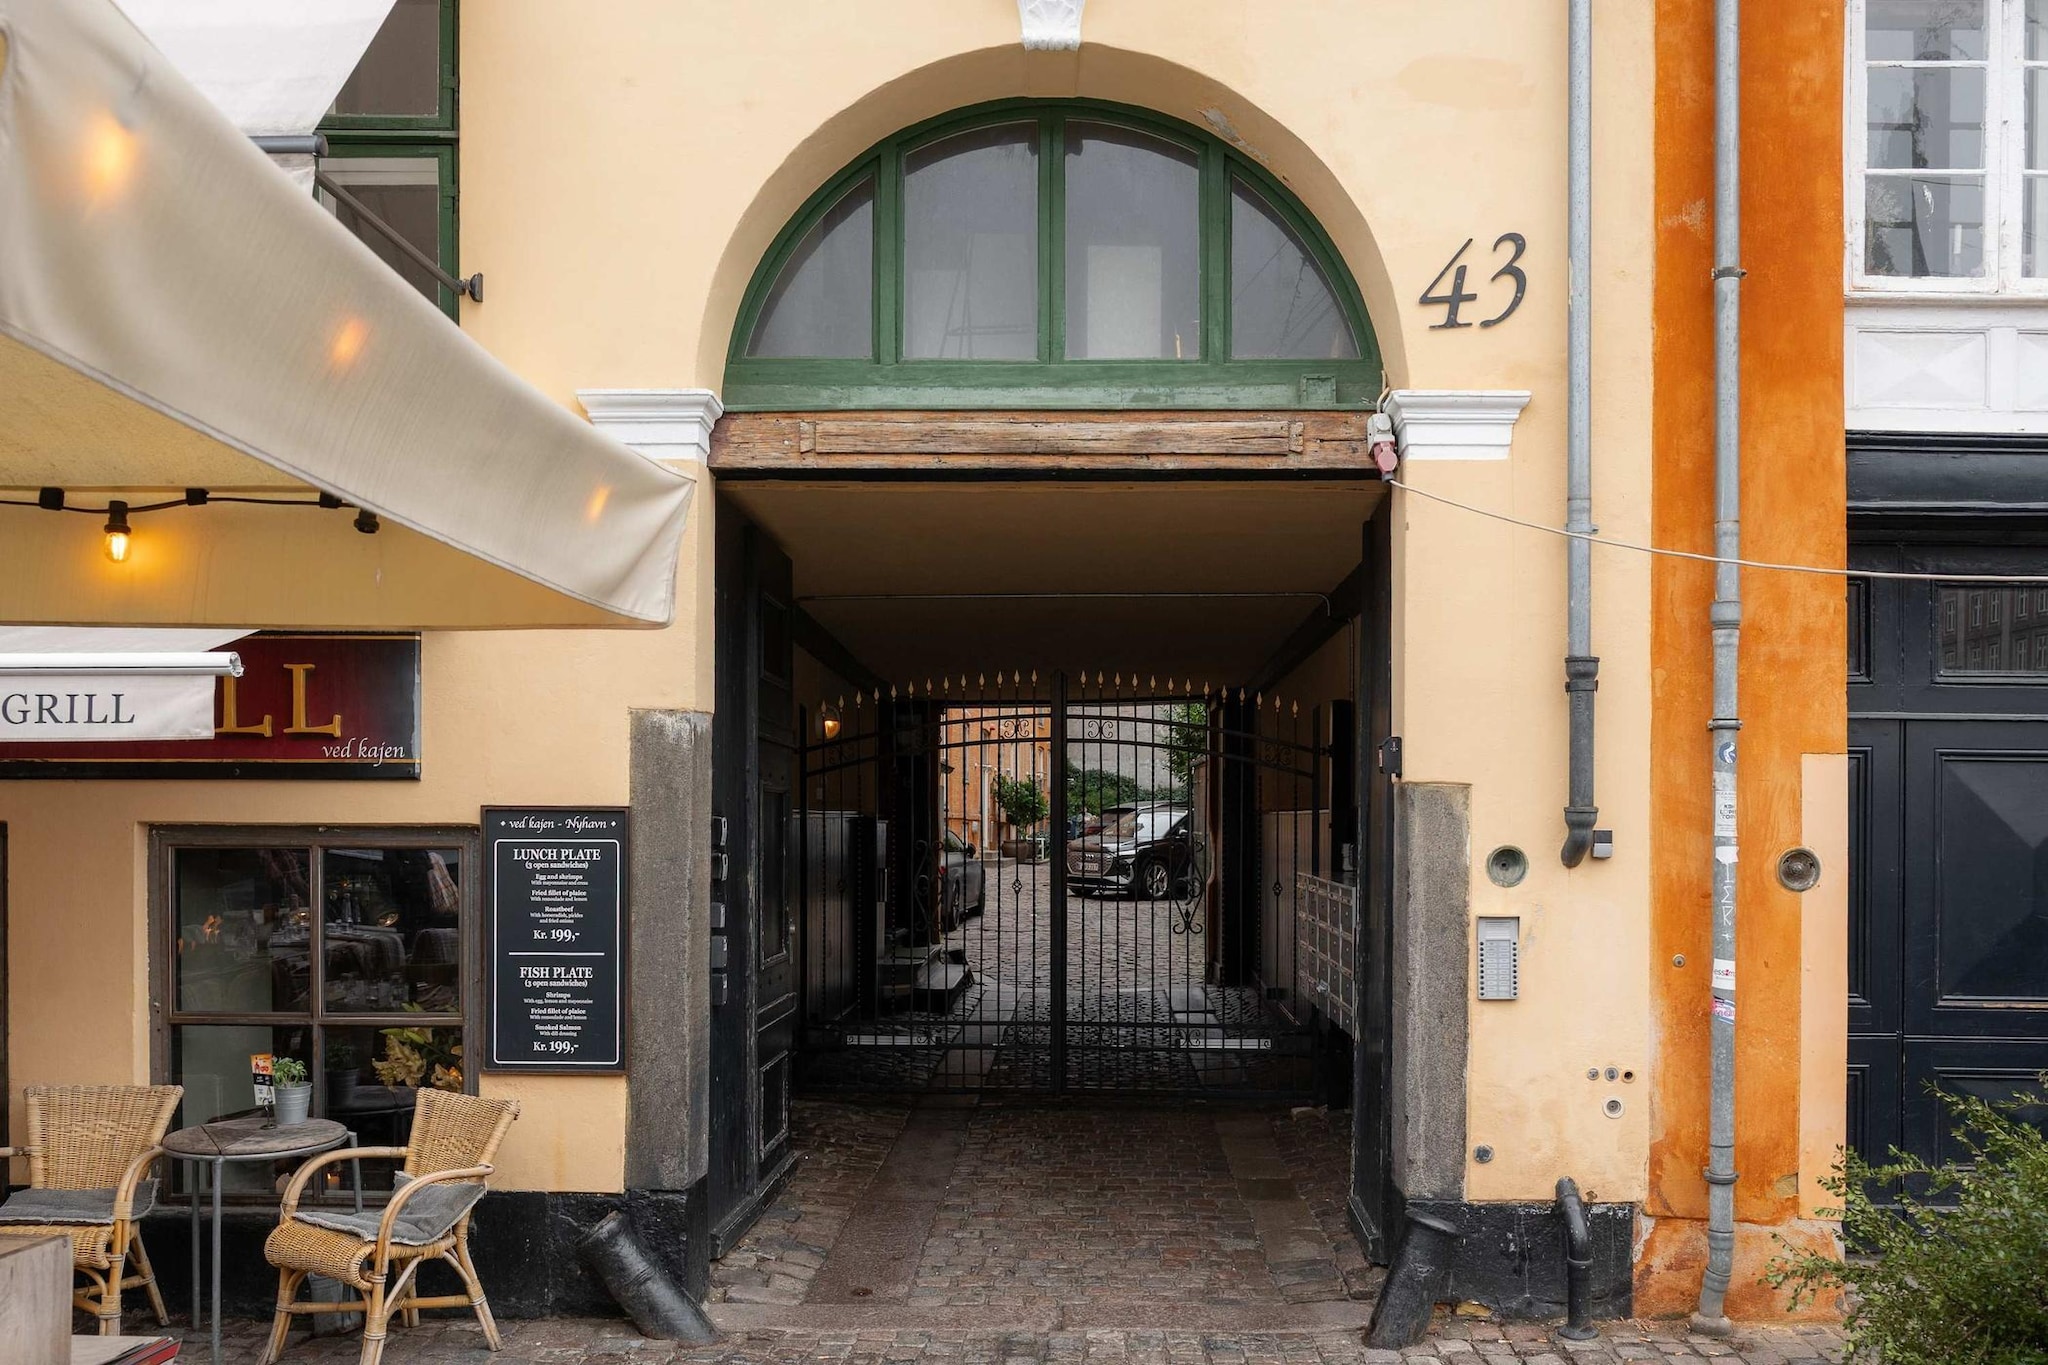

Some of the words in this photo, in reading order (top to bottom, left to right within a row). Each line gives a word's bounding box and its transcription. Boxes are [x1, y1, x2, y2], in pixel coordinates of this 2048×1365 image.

[1418, 231, 1527, 328] 43
[1, 693, 136, 725] GRILL
[322, 737, 357, 758] ved
[358, 737, 406, 767] kajen
[509, 815, 528, 829] ved
[528, 815, 554, 834] kajen
[565, 815, 607, 834] Nyhavn
[513, 848, 558, 861] LUNCH
[560, 848, 601, 861] PLATE
[525, 861, 533, 870] (3
[533, 862, 549, 870] open
[550, 861, 589, 870] sandwiches)
[559, 873, 583, 881] shrimps
[569, 889, 587, 897] plaice
[533, 929, 548, 940] Kr.
[550, 928, 580, 942] 199,-
[519, 966, 550, 979] FISH
[552, 966, 593, 979] PLATE
[524, 979, 532, 988] (3
[532, 980, 549, 988] open
[549, 979, 588, 988] sandwiches)
[545, 991, 571, 999] Shrimps
[568, 1008, 586, 1016] plaice
[532, 1041, 547, 1052] Kr.
[549, 1040, 579, 1054] 199,-
